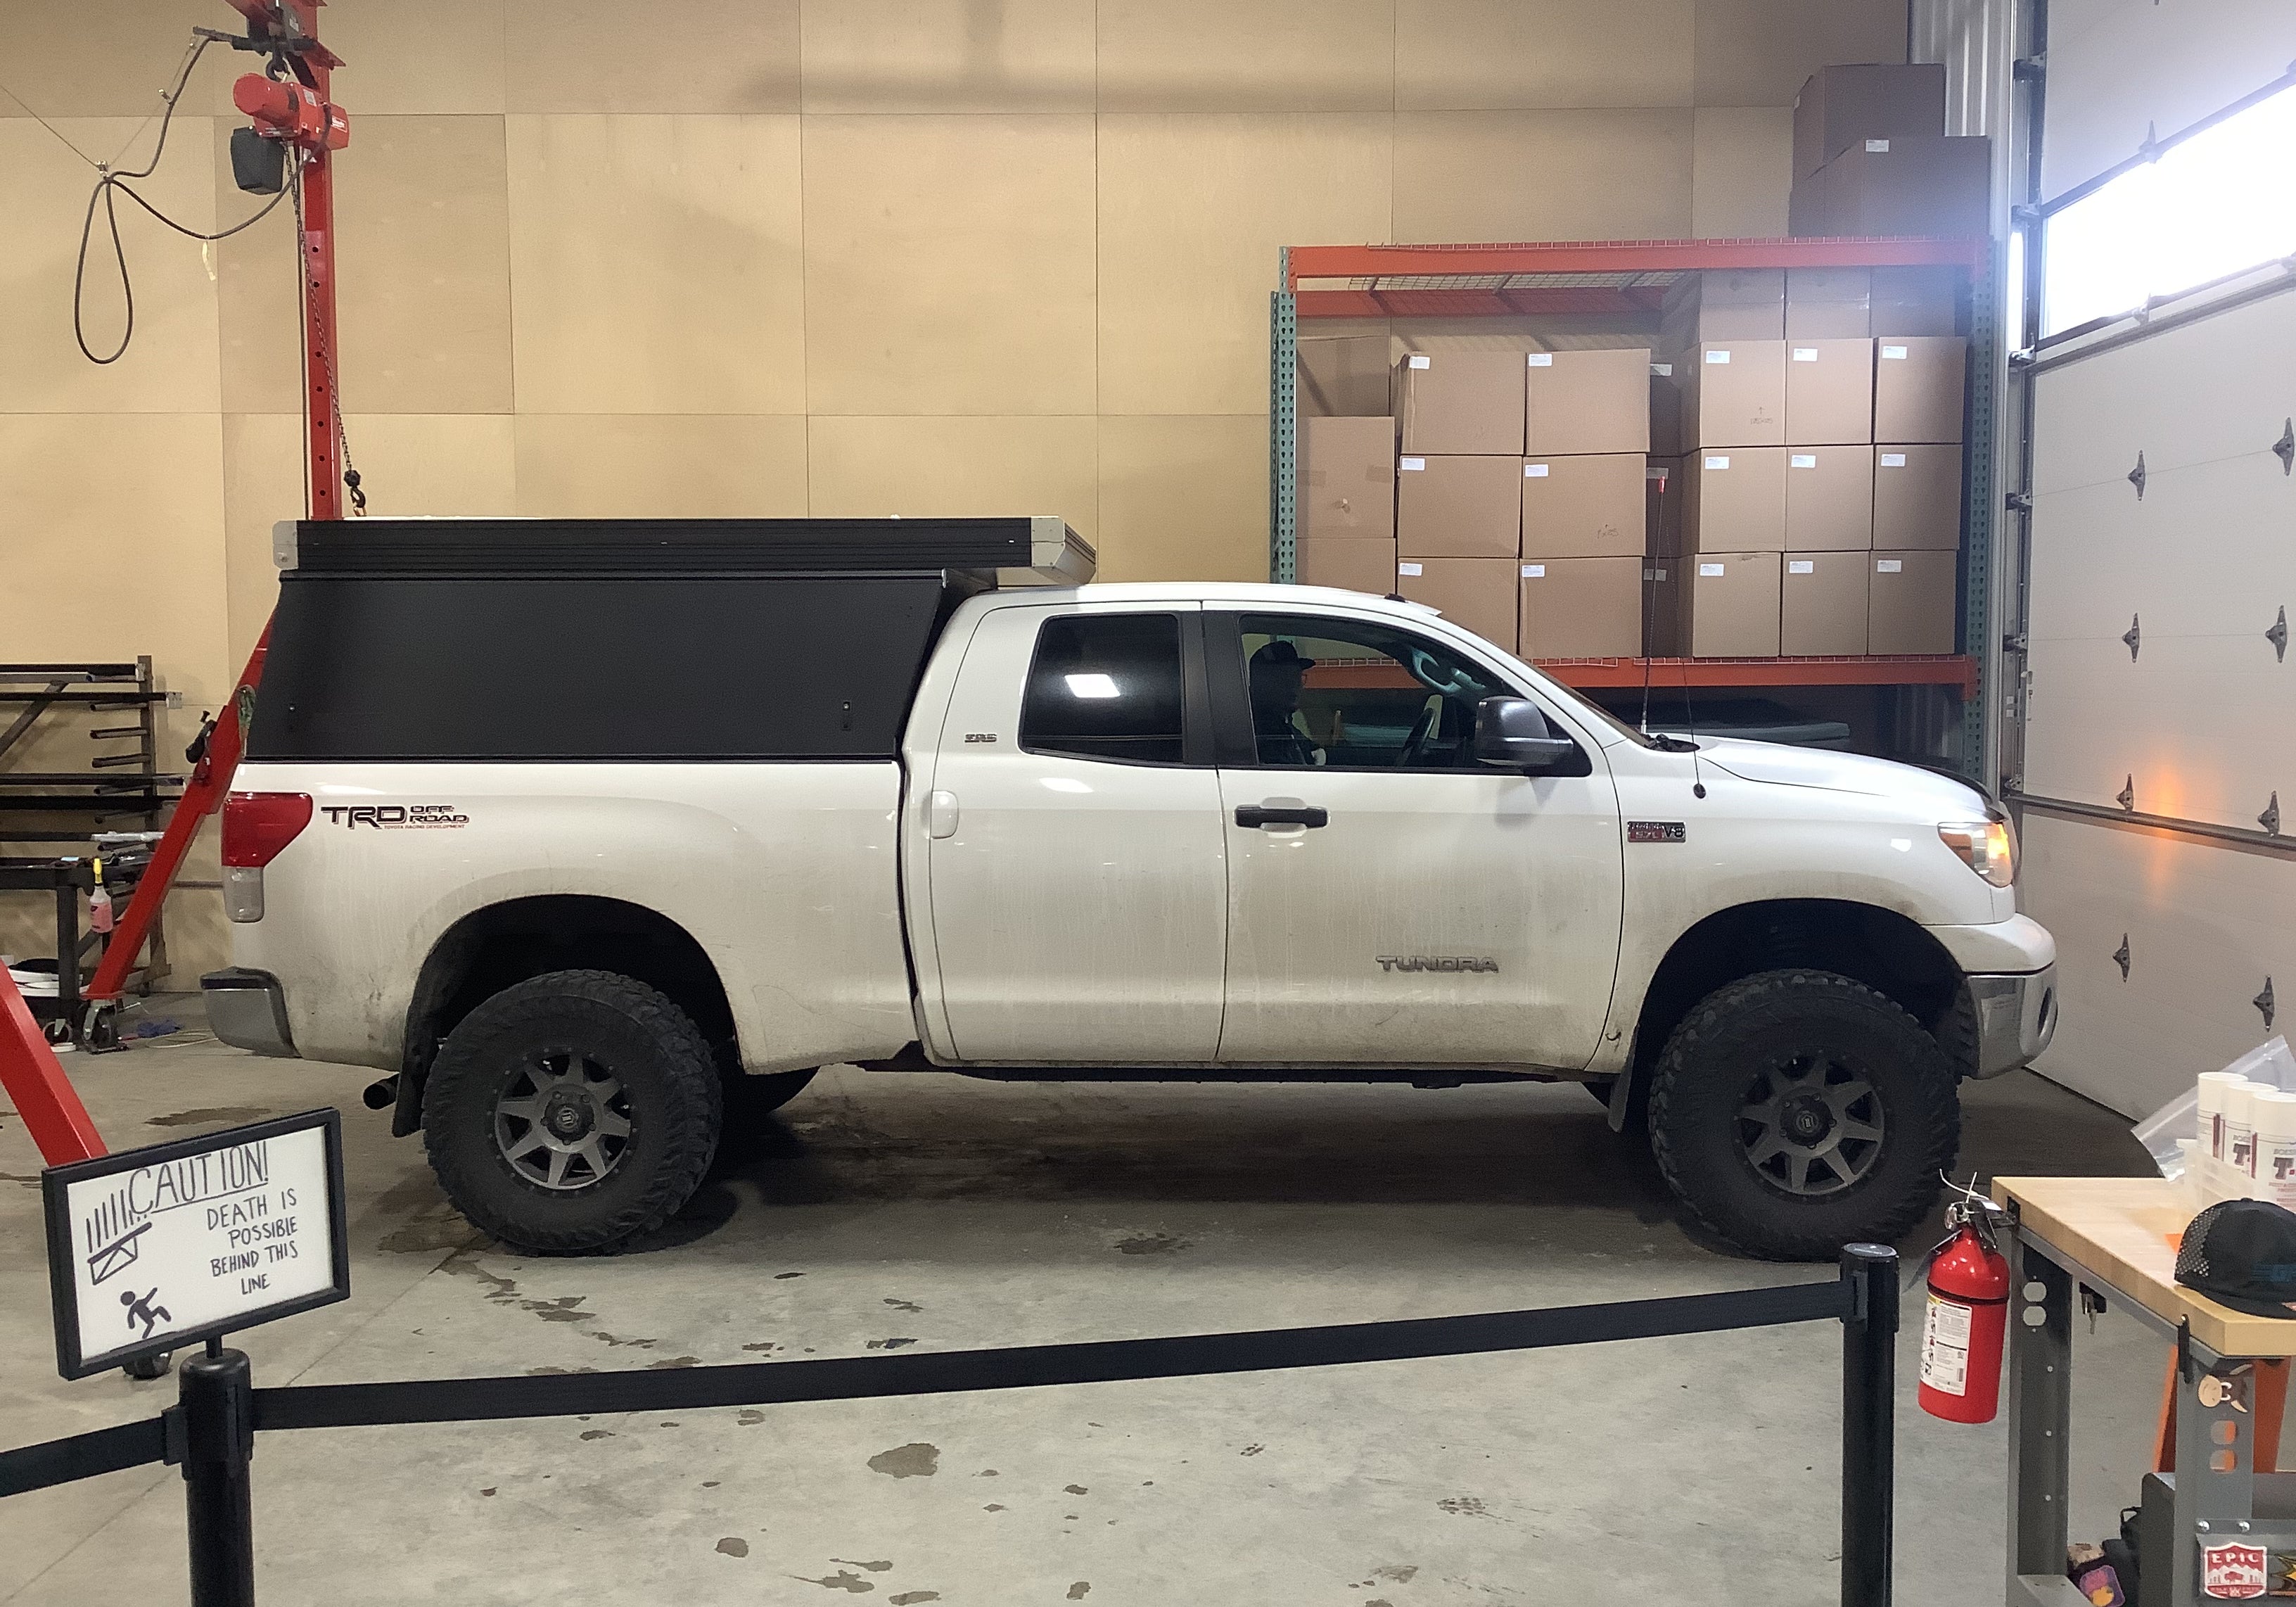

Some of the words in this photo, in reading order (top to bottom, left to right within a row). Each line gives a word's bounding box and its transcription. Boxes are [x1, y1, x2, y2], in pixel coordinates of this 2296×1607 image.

[321, 806, 408, 830] TRD
[409, 815, 469, 824] ROAD
[410, 806, 454, 814] OFF
[1376, 955, 1499, 973] TUNDRA
[129, 1141, 269, 1214] CAUTION!
[207, 1195, 268, 1231] DEATH
[281, 1188, 298, 1209] IS
[228, 1217, 298, 1249] POSSIBLE
[210, 1251, 260, 1277] BEHIND
[264, 1240, 299, 1265] THIS
[241, 1273, 271, 1295] LINE
[2212, 1553, 2259, 1563] EPIC
